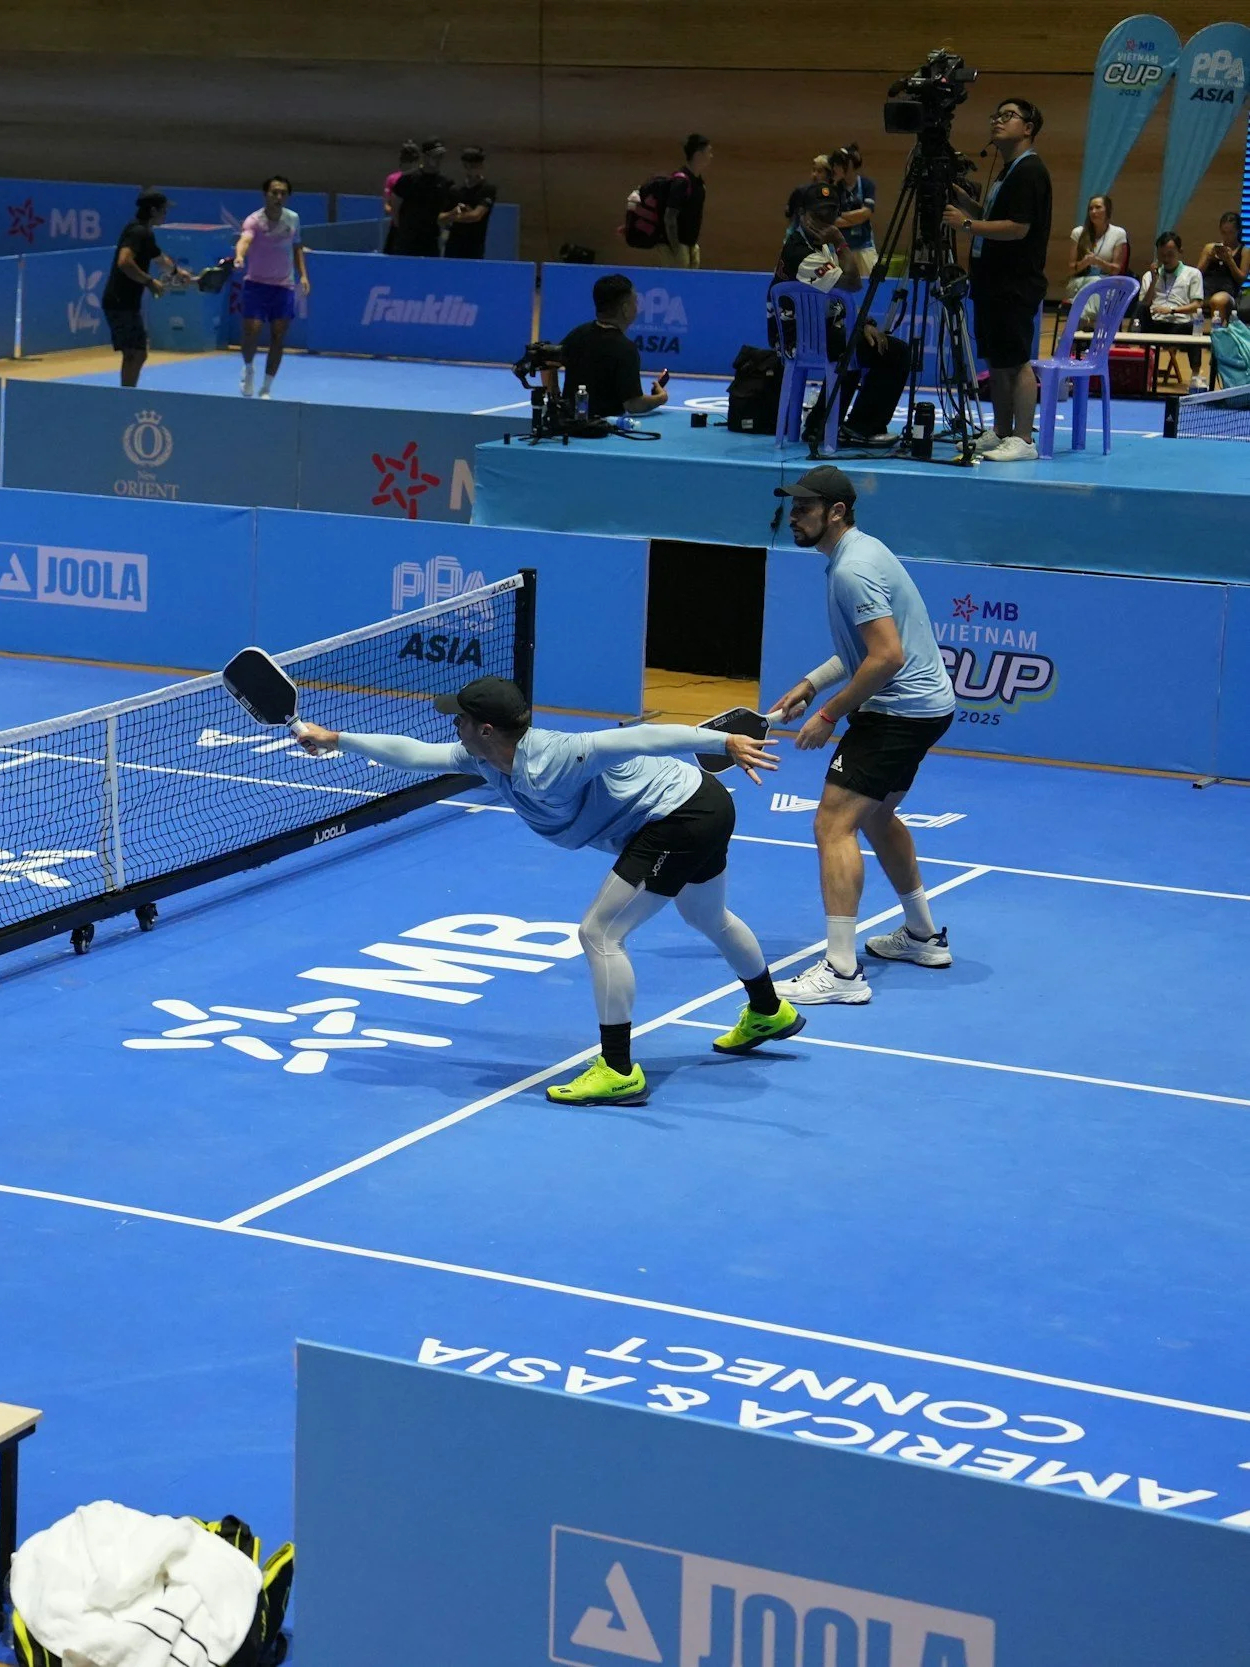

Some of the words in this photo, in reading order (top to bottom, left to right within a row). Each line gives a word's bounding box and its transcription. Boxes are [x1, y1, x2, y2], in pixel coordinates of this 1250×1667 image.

[1104, 63, 1162, 85] CUP
[1191, 49, 1245, 81] PPA
[1190, 87, 1235, 104] ASIA
[50, 207, 100, 240] MB
[361, 286, 479, 327] Franklin
[113, 480, 180, 500] ORIENT
[44, 556, 142, 601] JOOLA
[982, 600, 1019, 621] MB
[398, 632, 482, 667] ASIA
[934, 622, 1038, 652] VIETNAM
[958, 711, 1001, 726] 2025
[320, 823, 347, 842] JOOLA
[297, 913, 582, 1005] MB
[612, 1079, 640, 1093] Babolat
[417, 1337, 637, 1395] ASIA
[584, 1337, 1086, 1444] CONNECT
[647, 1384, 710, 1413] &
[739, 1399, 1218, 1511] AMERICA
